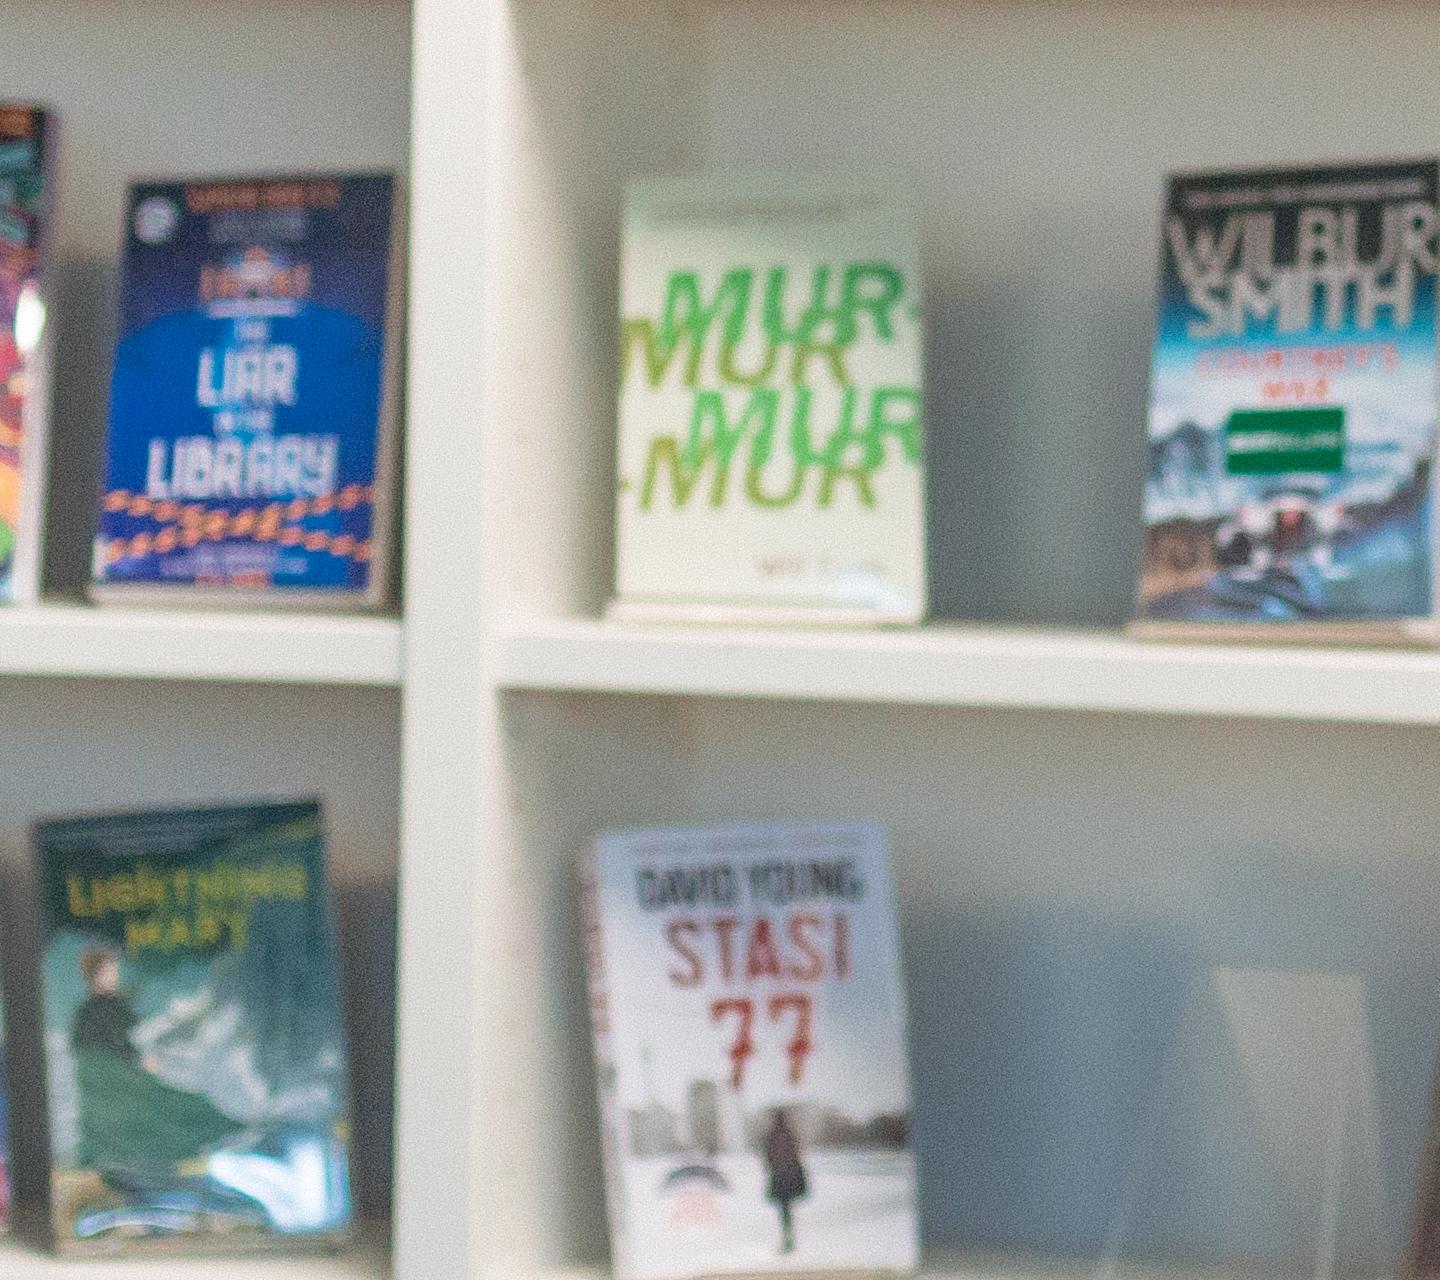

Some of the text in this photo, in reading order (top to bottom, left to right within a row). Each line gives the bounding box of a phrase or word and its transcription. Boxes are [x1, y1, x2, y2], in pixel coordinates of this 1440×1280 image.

[1167, 203, 1440, 287] WILBUR
[1187, 258, 1415, 340] SMITH
[197, 345, 298, 408] LIAR
[146, 434, 341, 500] LIBRARY
[636, 861, 737, 911] DAVID
[665, 911, 852, 989] STASI
[708, 992, 815, 1091] 77
